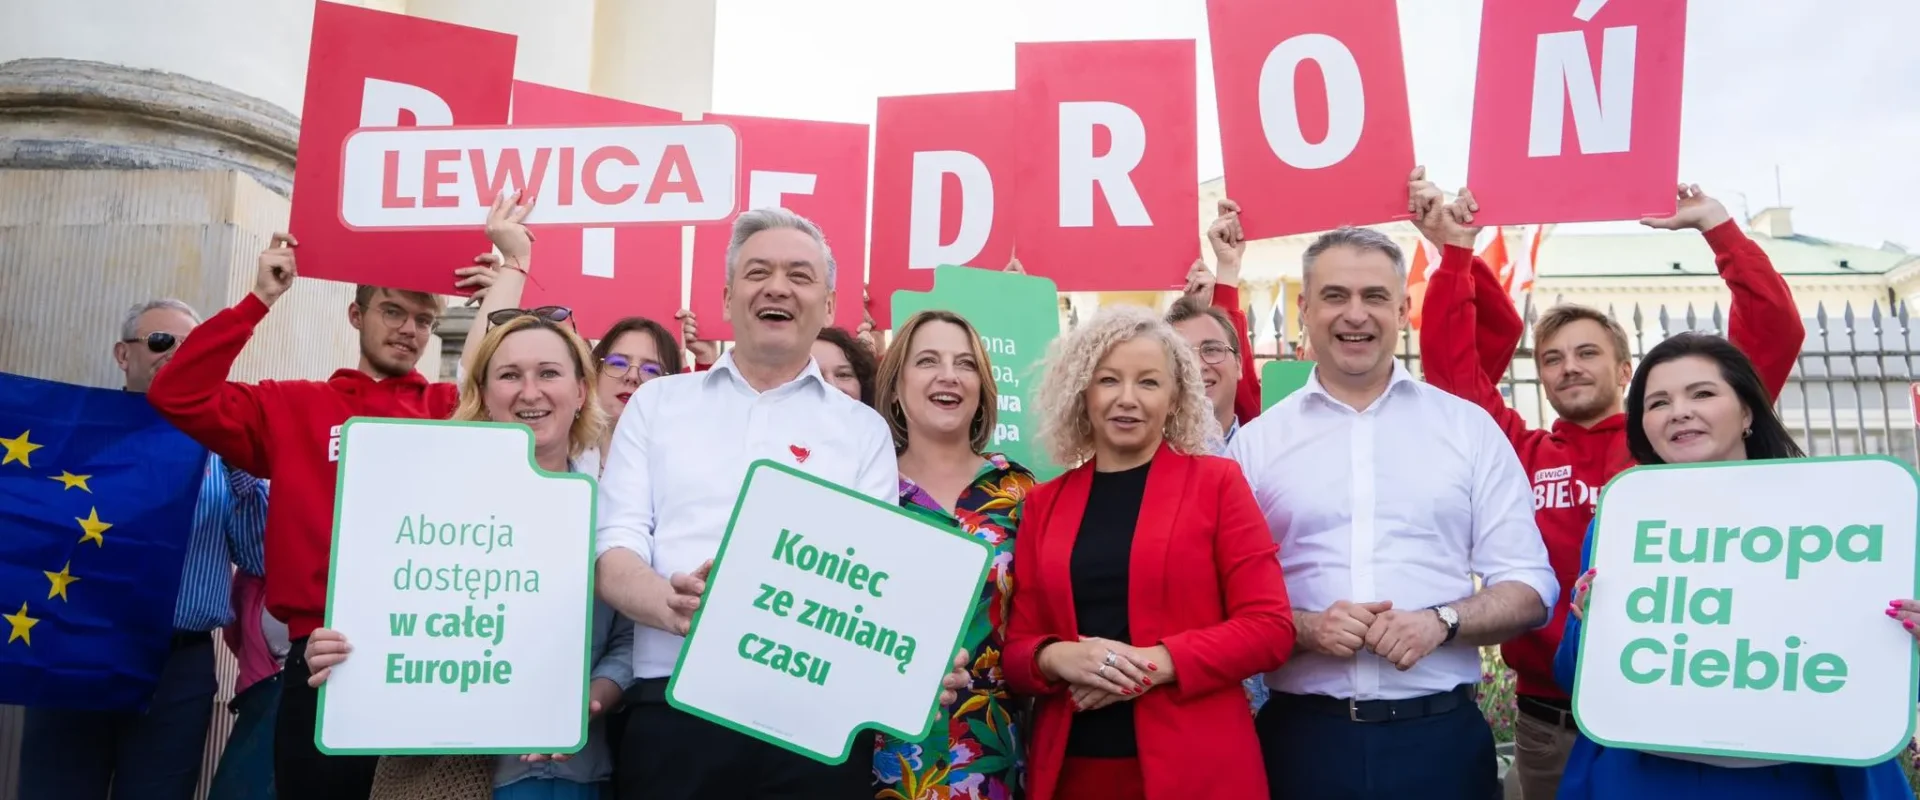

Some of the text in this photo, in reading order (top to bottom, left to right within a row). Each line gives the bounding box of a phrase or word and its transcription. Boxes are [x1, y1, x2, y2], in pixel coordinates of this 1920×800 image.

[382, 145, 703, 208] LEWICA
[1536, 468, 1569, 480] LEWICA
[395, 514, 513, 554] Aborcja
[1633, 520, 1883, 580] Europa
[393, 559, 539, 600] dostępna
[771, 528, 889, 598] Koniec
[389, 603, 505, 646] w całej
[1627, 576, 1733, 625] dla
[752, 583, 917, 675] ze zmianą
[385, 649, 512, 693] Europie
[737, 632, 832, 687] czasu
[1619, 633, 1848, 694] Ciebie
